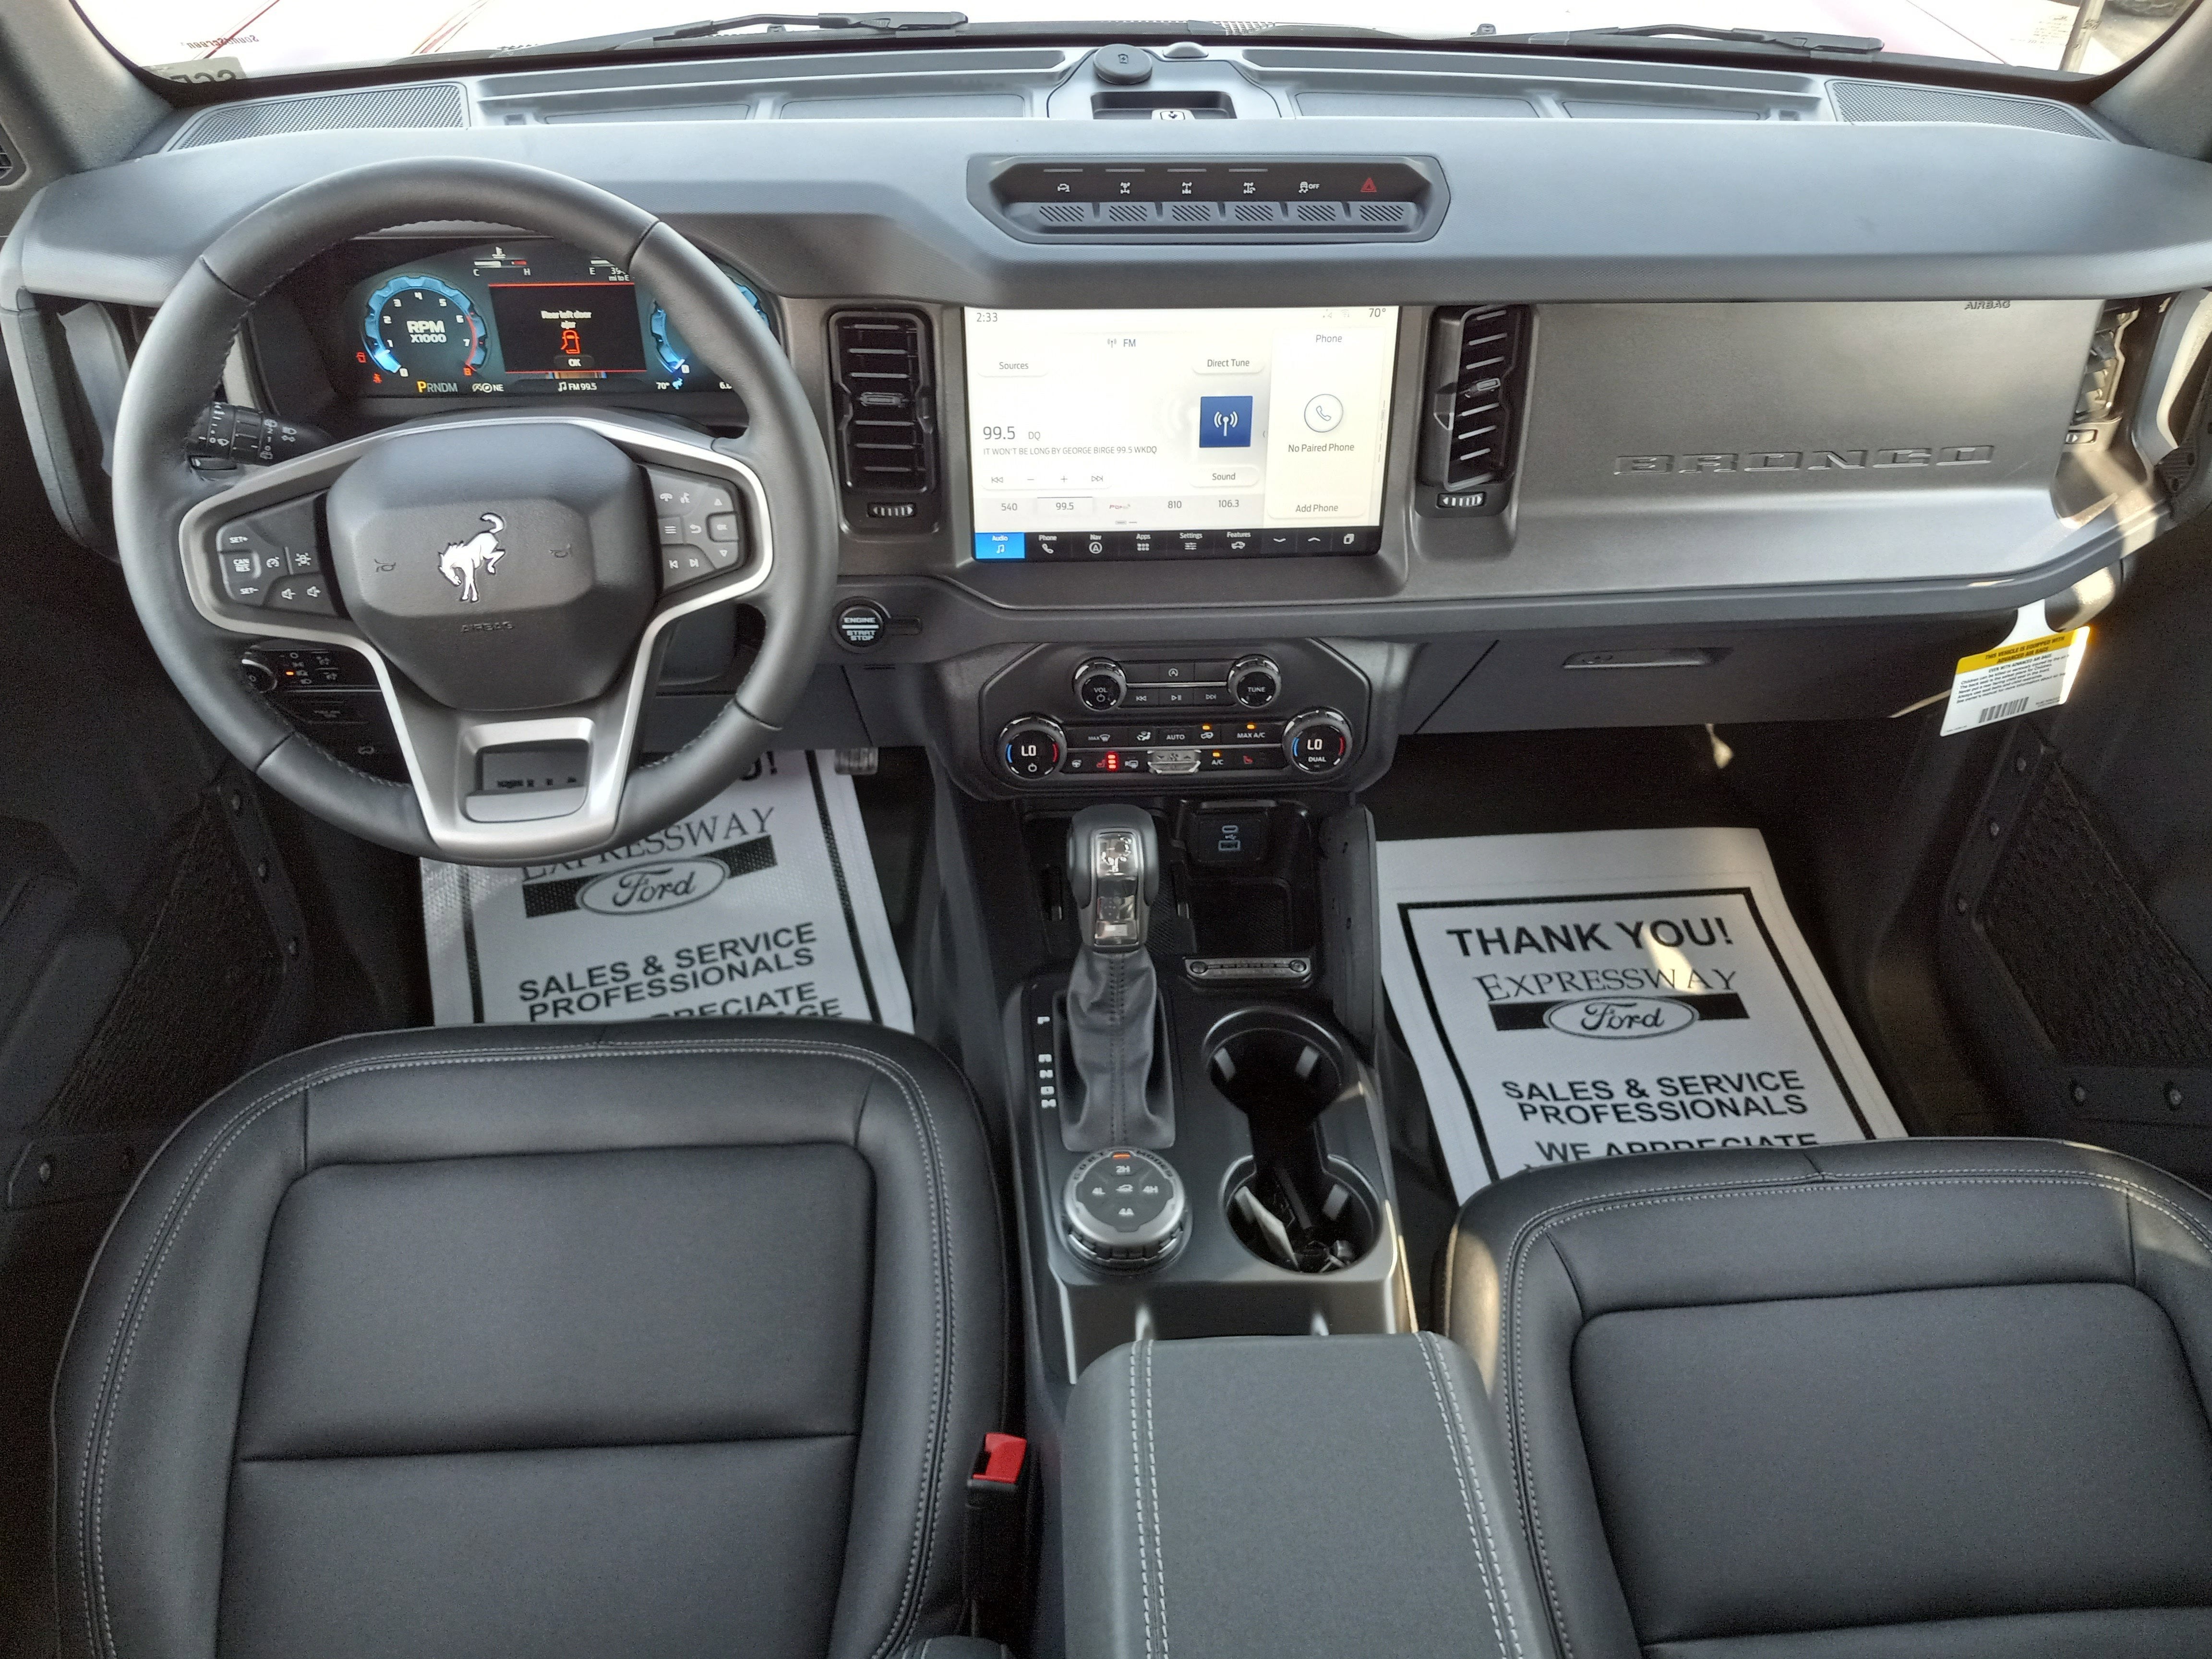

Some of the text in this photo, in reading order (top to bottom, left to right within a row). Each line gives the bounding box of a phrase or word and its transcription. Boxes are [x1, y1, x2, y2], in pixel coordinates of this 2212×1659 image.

[589, 267, 596, 275] E
[414, 291, 423, 300] 4
[393, 299, 402, 307] 3
[439, 298, 447, 307] 5
[1963, 300, 2010, 310] AIRBAG
[976, 312, 998, 323] 2:33
[1368, 308, 1387, 318] 70°
[383, 315, 392, 324] 2
[456, 314, 464, 324] 6
[407, 320, 446, 334] RPM
[387, 339, 394, 348] 1
[463, 338, 470, 347] 7
[1122, 338, 1137, 348] FM
[1315, 334, 1343, 343] Phone
[568, 358, 582, 367] OK
[998, 361, 1029, 370] Sources
[1206, 358, 1250, 368] Direct Tune
[399, 367, 409, 377] 0
[463, 366, 472, 376] 8
[982, 426, 1041, 441] 99.5 DQ
[991, 447, 1017, 456] WON'T
[1062, 446, 1092, 455] GEORGE
[1116, 446, 1133, 454] 99.5
[1133, 446, 1157, 455] WKDQ
[1288, 443, 1355, 453] No Paired Phone
[1613, 444, 1995, 476] BRONCO
[1212, 472, 1236, 481] Sound
[1001, 503, 1018, 512] 540
[1055, 502, 1074, 511] 99.5
[1167, 500, 1182, 509] 810
[1218, 499, 1239, 508] 106.3
[1295, 504, 1339, 513] Add Phone
[1136, 533, 1151, 541] Apps
[1307, 738, 1323, 751] LO
[1021, 745, 1037, 757] LO
[612, 867, 696, 907] Ford
[1445, 917, 1734, 957] THANK YOU!
[518, 922, 817, 1002] SALES & SERVICE
[529, 947, 815, 1022] PROFESSIONALS
[1580, 1001, 1665, 1031] Ford
[1502, 1070, 1806, 1102] SALES & SERVICE
[1517, 1094, 1808, 1125] PROFESSIONALS
[1116, 1165, 1131, 1174] 2H
